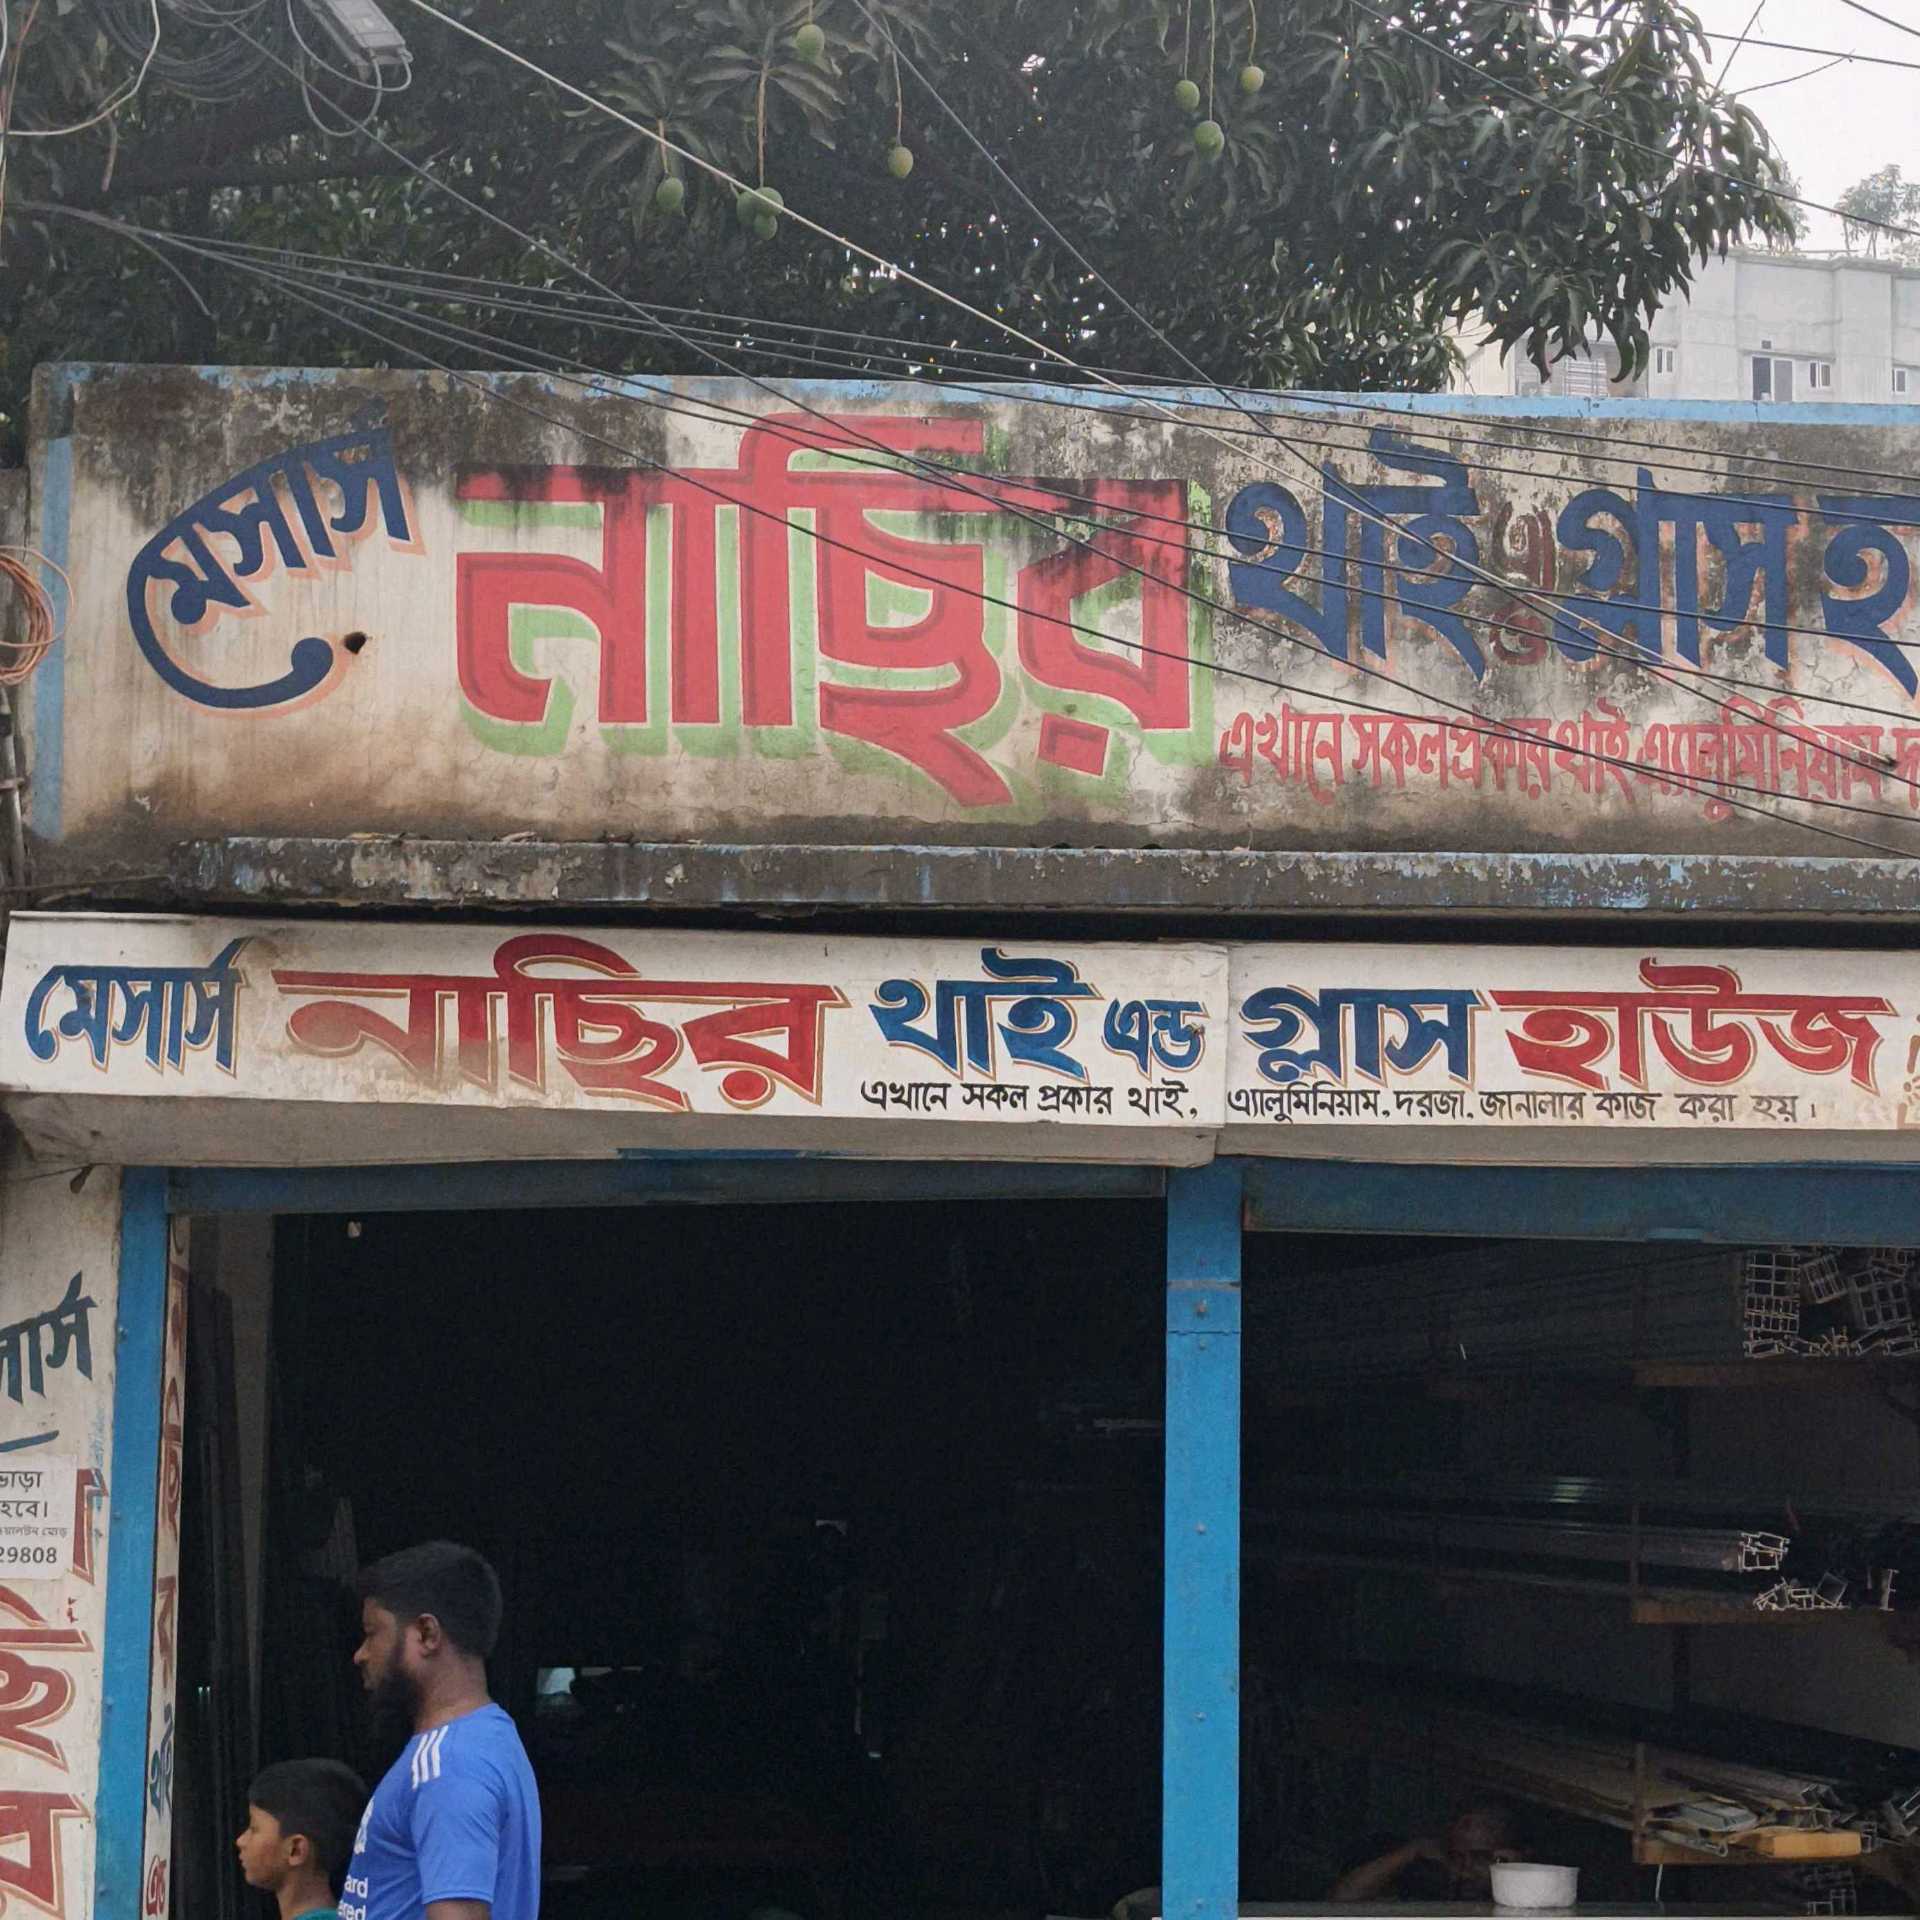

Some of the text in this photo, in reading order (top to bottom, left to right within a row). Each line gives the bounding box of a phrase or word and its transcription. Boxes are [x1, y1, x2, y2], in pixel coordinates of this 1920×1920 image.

[455, 412, 1200, 808] নাছির
[1225, 424, 1486, 682] থাই
[1218, 703, 1345, 804] এখানে
[1349, 713, 1450, 790] সকল
[25, 936, 248, 1078] মেসার্স
[271, 934, 852, 1112] নাছির
[868, 947, 1104, 1084] থাই
[1240, 984, 1492, 1090] গ্লাস
[1488, 957, 1899, 1097] হাউজ
[861, 1080, 951, 1113] এখানে
[961, 1082, 1029, 1112] সকল
[1038, 1084, 1114, 1116] প্রকার
[1478, 1090, 1587, 1121] জানালার
[1593, 1091, 1662, 1122] কাজ
[1674, 1093, 1738, 1123] করা
[0, 1546, 58, 1566] 29808
